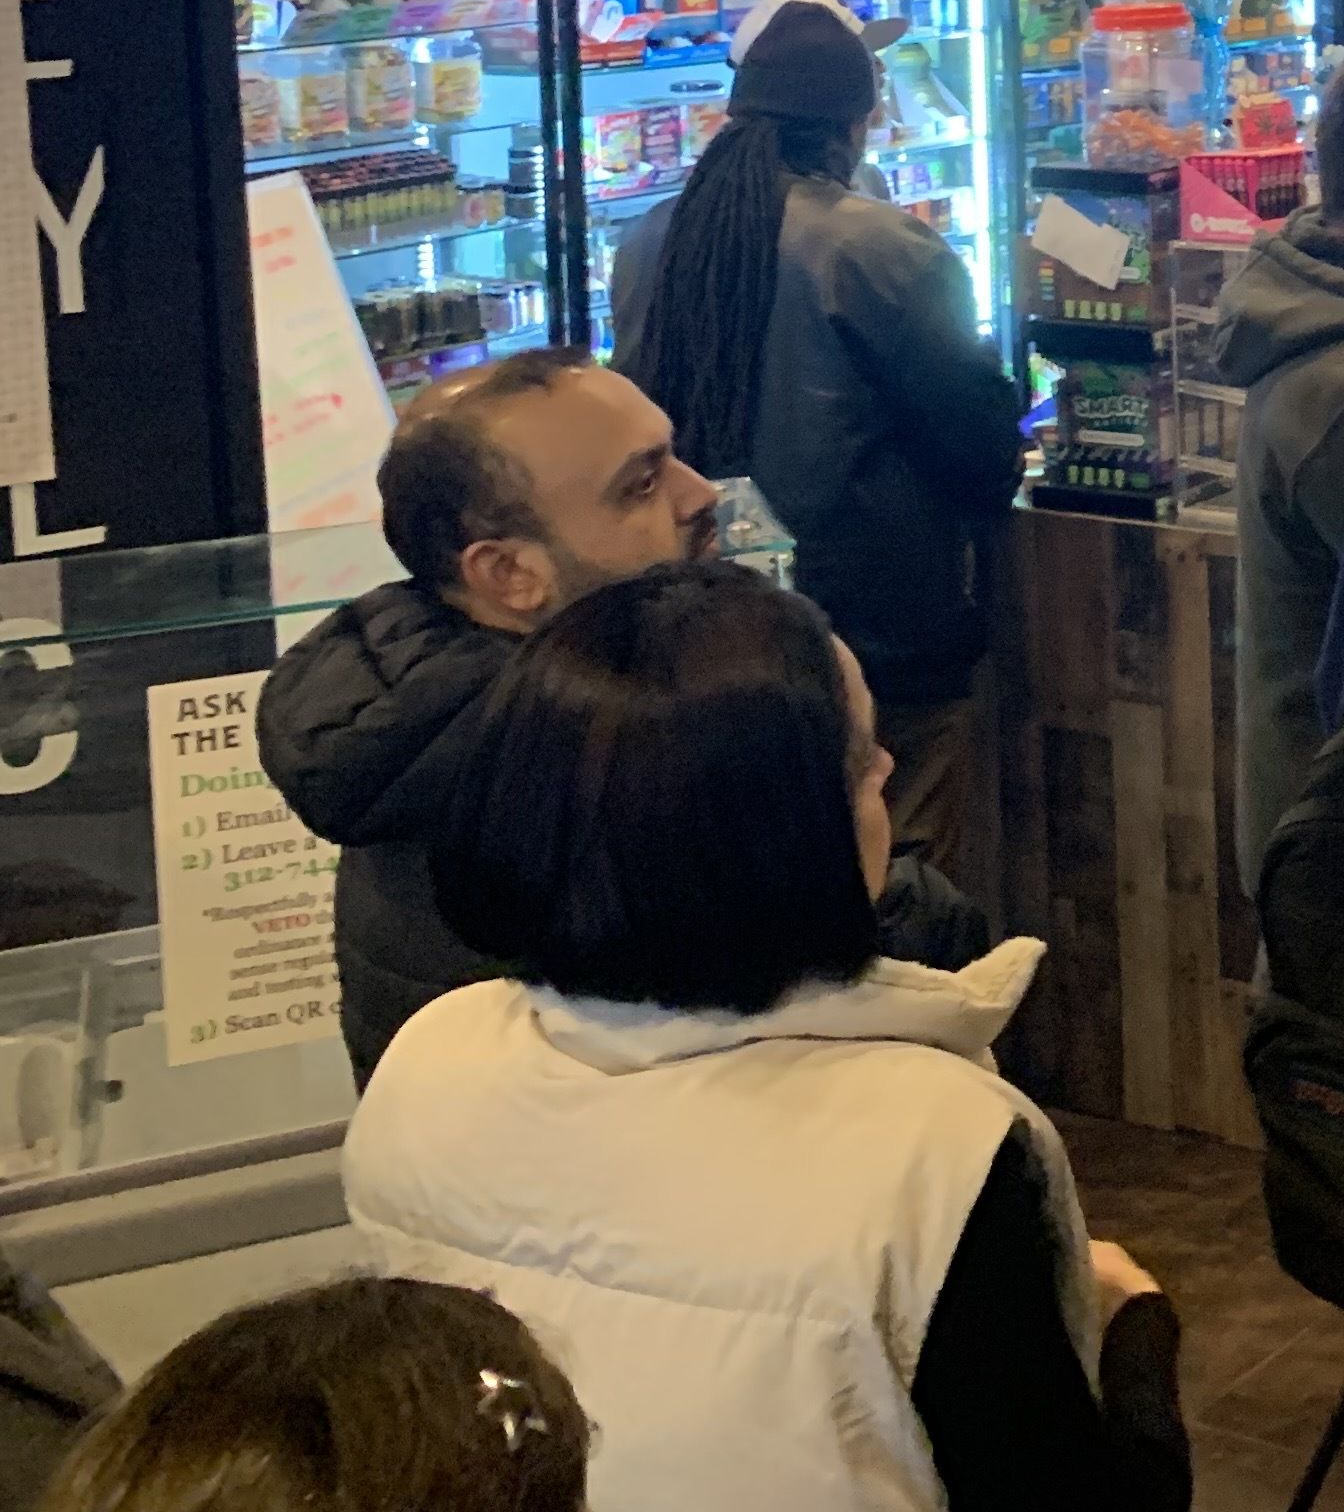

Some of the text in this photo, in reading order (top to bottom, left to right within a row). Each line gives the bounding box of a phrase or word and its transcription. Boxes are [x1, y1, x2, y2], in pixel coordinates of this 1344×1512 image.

[177, 690, 248, 723] ASK
[171, 725, 241, 756] THE
[180, 766, 274, 798] Doin
[216, 803, 292, 832] Email
[181, 848, 213, 870] 2)
[222, 838, 297, 864] Leave
[225, 1012, 281, 1034] Scan
[286, 1000, 324, 1025] QR
